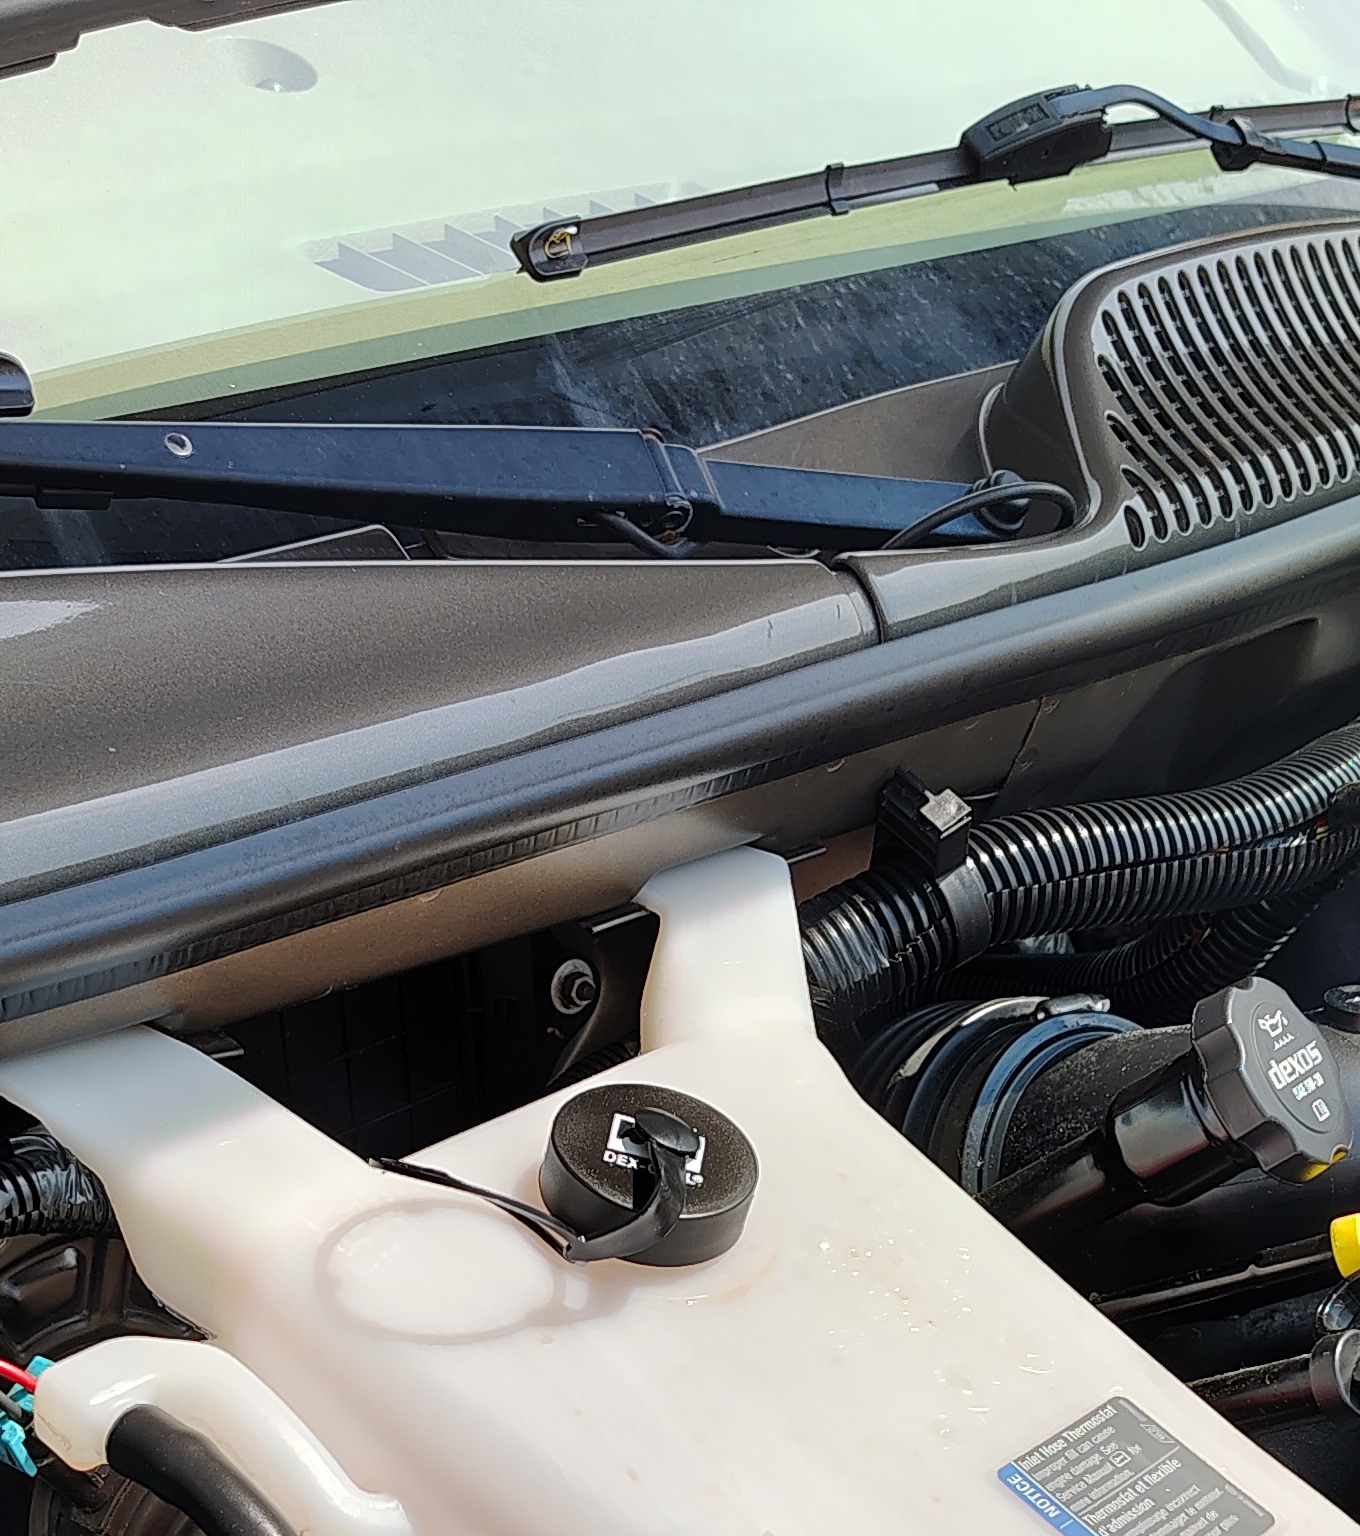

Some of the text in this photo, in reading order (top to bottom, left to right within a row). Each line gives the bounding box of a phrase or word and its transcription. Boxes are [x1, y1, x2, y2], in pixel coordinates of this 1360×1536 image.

[1267, 1040, 1324, 1091] dexos
[1018, 1453, 1046, 1471] Inlet
[1039, 1439, 1067, 1458] Hose
[1061, 1404, 1118, 1442] Thermostat
[1077, 1440, 1094, 1453] can
[1091, 1426, 1116, 1444] cause
[1100, 1442, 1118, 1455] See
[1006, 1472, 1062, 1518] NOTICE
[1055, 1481, 1087, 1502] Service
[1082, 1457, 1182, 1526] Thermostat et flexible
